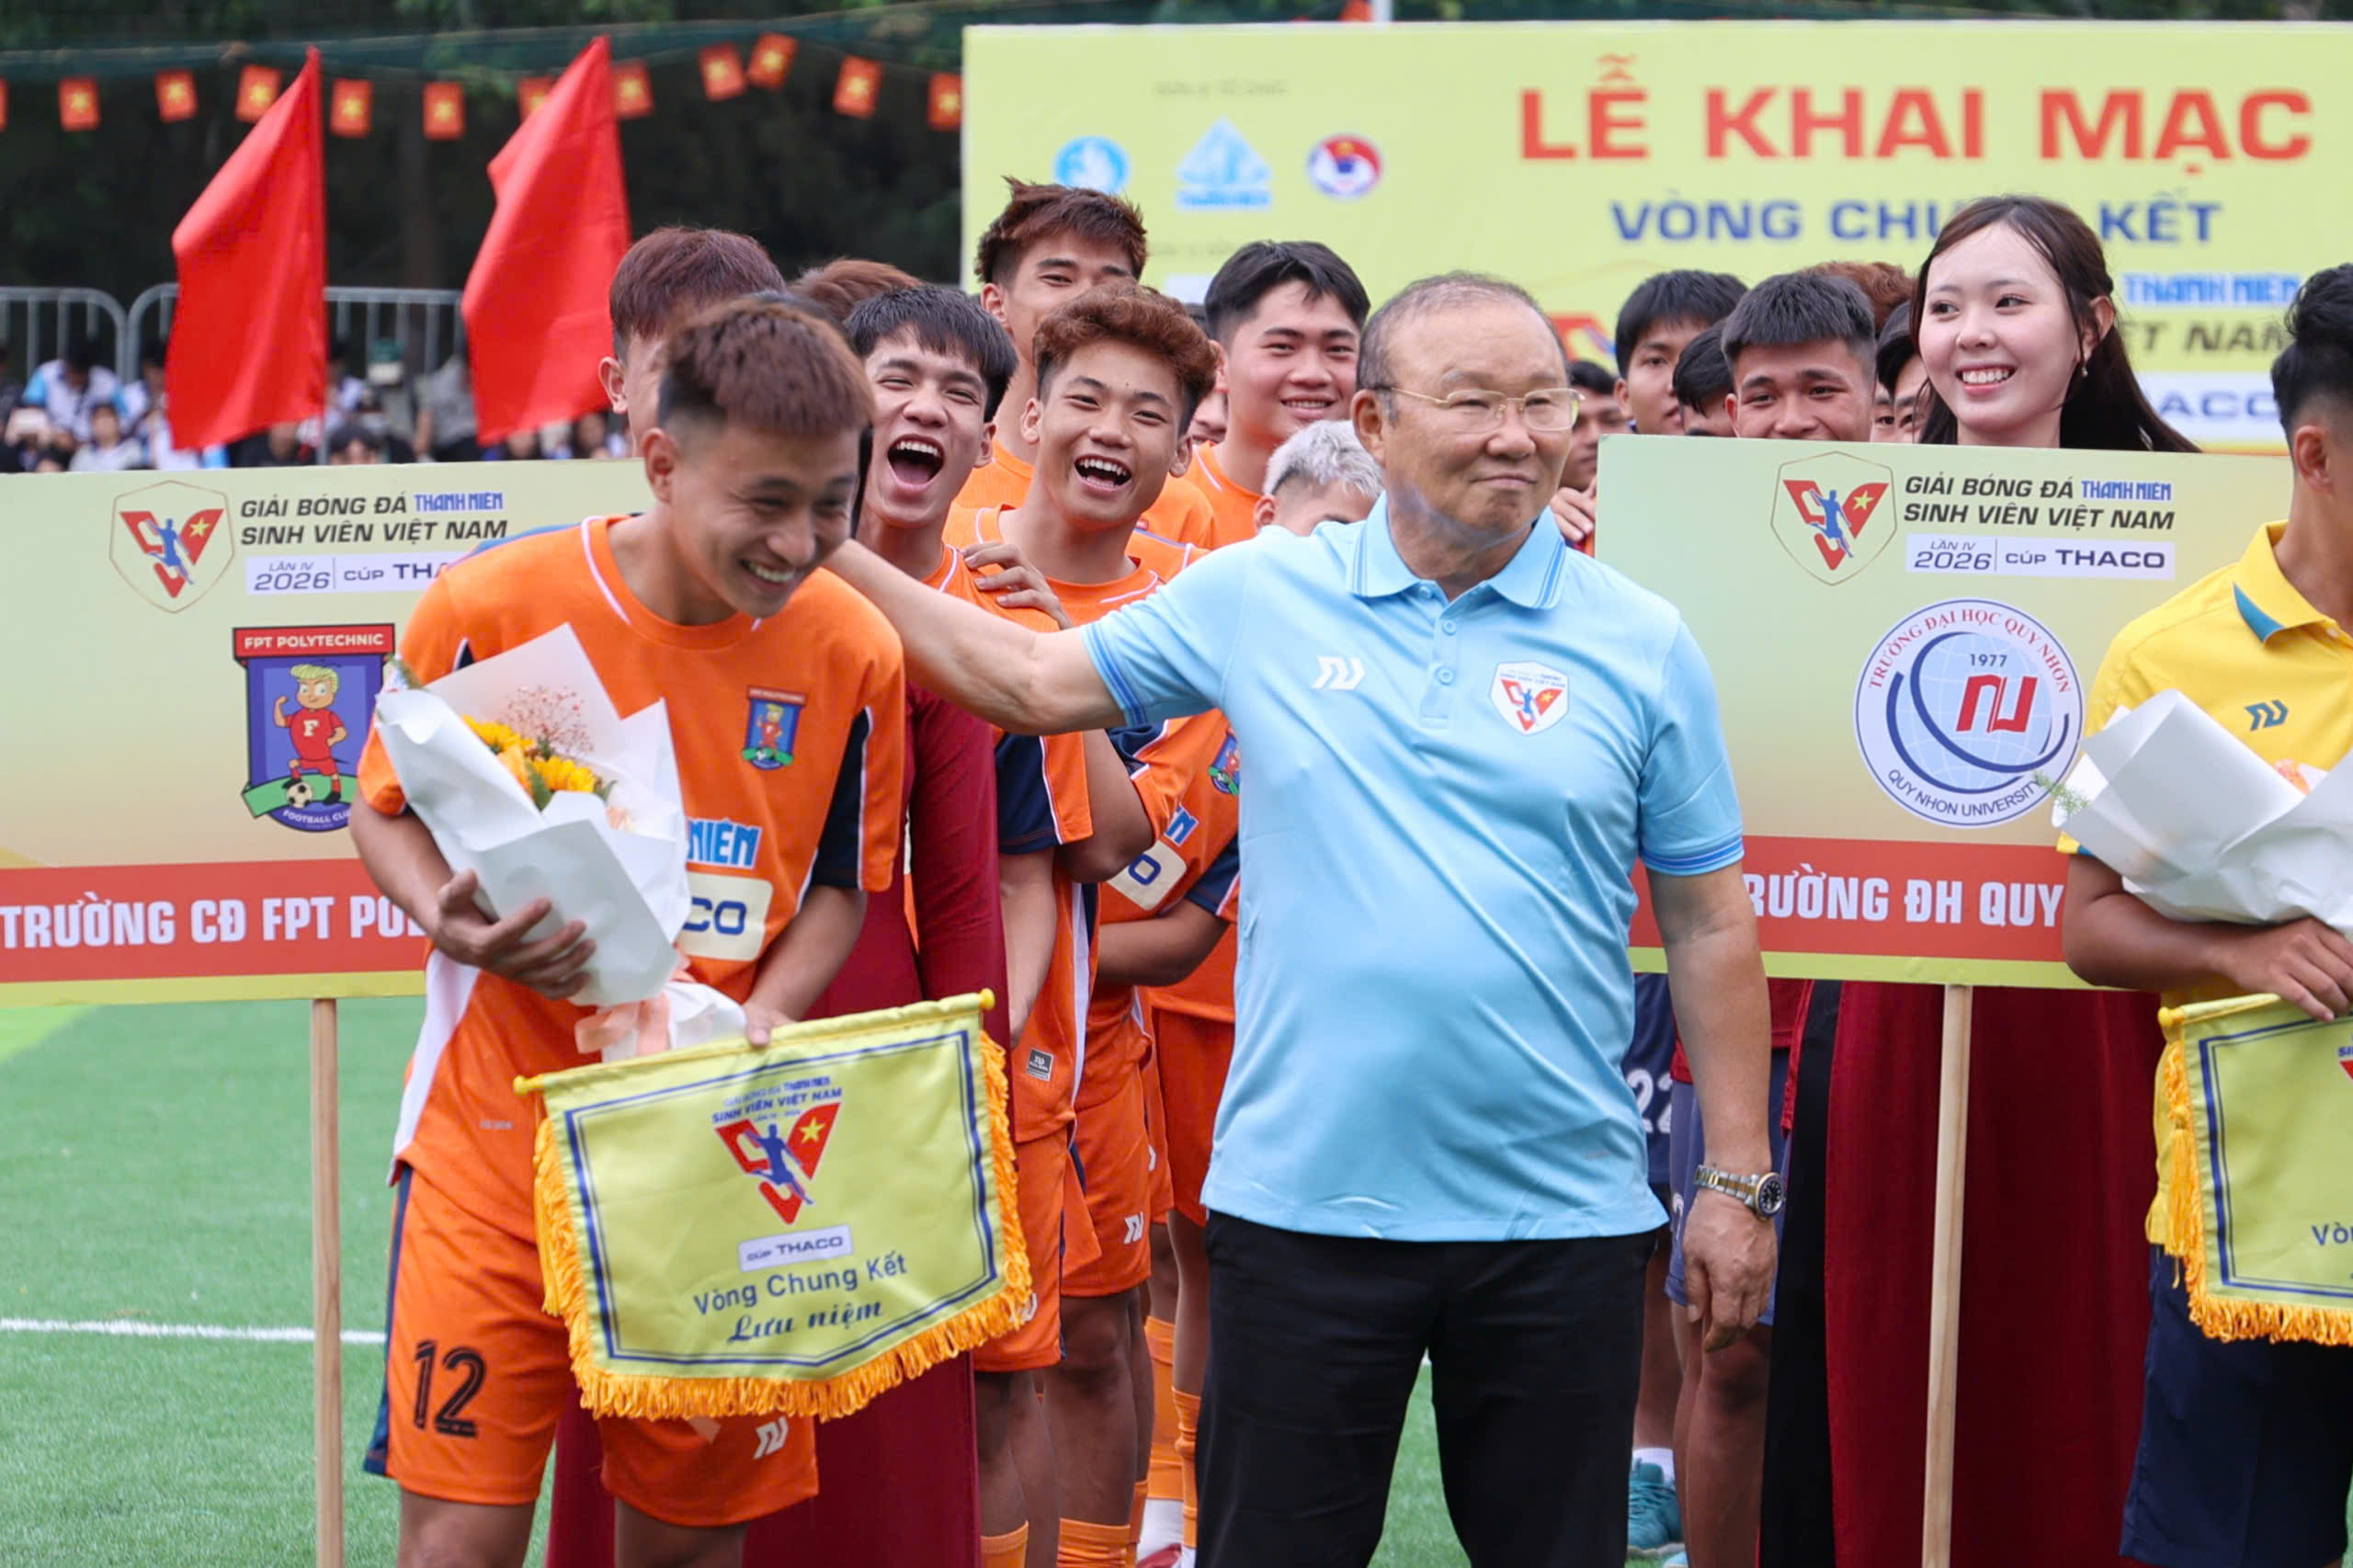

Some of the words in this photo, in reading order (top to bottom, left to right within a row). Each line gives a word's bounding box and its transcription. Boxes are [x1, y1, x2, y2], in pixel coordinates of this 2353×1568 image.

[1520, 52, 1649, 159] LỄ
[1705, 86, 1985, 160] KHAI
[2039, 87, 2313, 175] MẠC
[1611, 187, 1802, 242] VÒNG
[2098, 187, 2222, 243] KẾT
[1905, 472, 1955, 495] GIẢI
[1961, 473, 2034, 498] BÓNG
[2040, 476, 2075, 499] ĐÁ
[2081, 480, 2132, 500] THANH
[241, 494, 288, 517] GIẢI
[297, 493, 366, 516] BÓNG
[374, 490, 407, 514] ĐÁ
[414, 493, 465, 512] THANH
[1904, 503, 1970, 523] SINH
[1978, 502, 2039, 525] VIÊN
[2048, 505, 2104, 531] VIỆT
[2110, 510, 2176, 529] NAM
[241, 526, 304, 545] SINH
[314, 520, 374, 543] VIÊN
[383, 518, 438, 545] VIỆT
[445, 520, 508, 540] NAM
[1962, 541, 1976, 551] IV
[301, 562, 314, 572] IV
[1914, 551, 1993, 571] 2026
[2005, 550, 2047, 565] CÚP
[2054, 549, 2165, 569] THACO
[254, 572, 330, 591] 2026
[344, 566, 384, 581] CÚP
[244, 637, 273, 650] FPT
[277, 633, 384, 649] POLYTECHNIC
[1869, 624, 1923, 689] TRƯỜNG
[1925, 609, 1957, 630] ĐẠI
[1961, 608, 2002, 626] HỌC
[2005, 617, 2041, 646] QUY
[1970, 653, 2007, 668] 1977
[1888, 769, 1917, 795] QUY
[1915, 791, 1959, 816] NHON
[1961, 778, 2041, 817] UNIVERSITY
[282, 809, 331, 824] FOOTBALL
[1904, 880, 1963, 924] ĐH
[1979, 882, 2065, 927] QUY
[0, 891, 176, 949] TRƯỜNG
[190, 899, 246, 944] CĐ
[262, 896, 335, 941] FPT
[776, 1236, 844, 1256] THACO
[2311, 1221, 2353, 1246] Vò
[694, 1285, 757, 1315] Vòng
[767, 1267, 858, 1298] Chung
[866, 1250, 907, 1280] Kết
[726, 1313, 794, 1345] Lưu
[807, 1301, 883, 1330] niệm
[414, 1340, 486, 1437] 12
